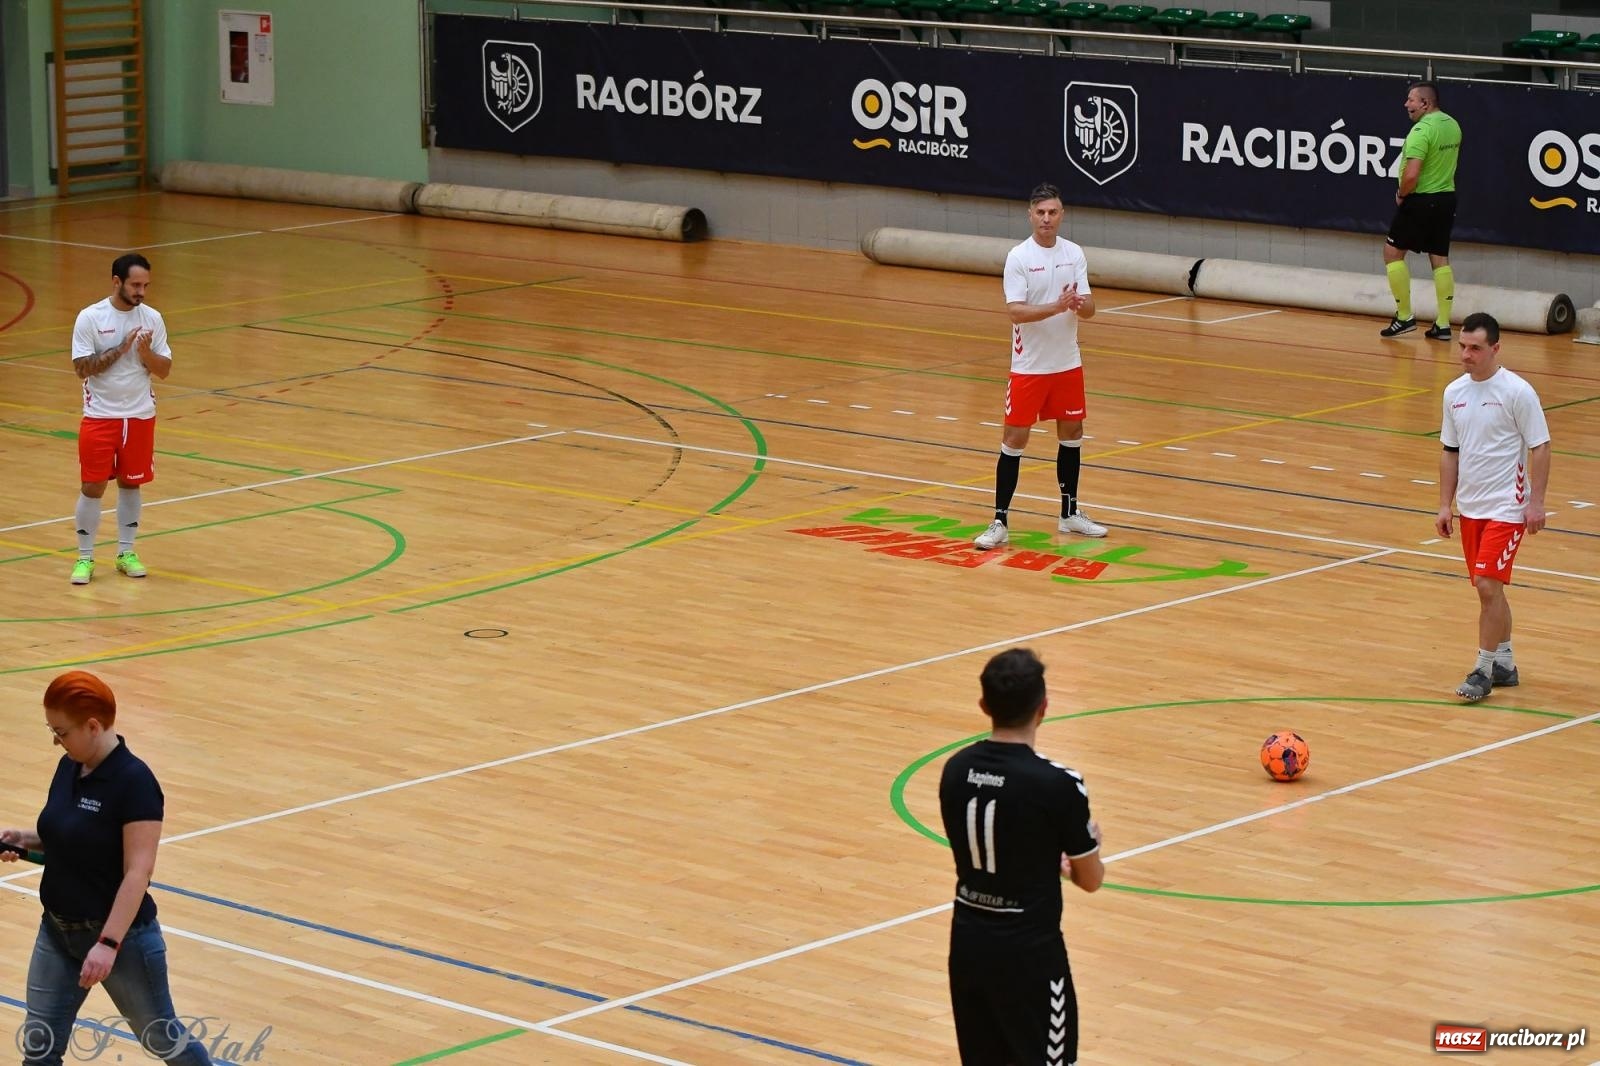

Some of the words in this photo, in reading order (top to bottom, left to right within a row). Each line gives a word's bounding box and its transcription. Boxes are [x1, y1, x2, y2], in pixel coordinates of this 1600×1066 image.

[575, 70, 762, 125] RACIBÓRZ
[898, 134, 969, 159] RACIBÓRZ
[1182, 118, 1404, 179] RACIBÓRZ
[1586, 197, 1600, 214] R
[966, 796, 996, 874] 11
